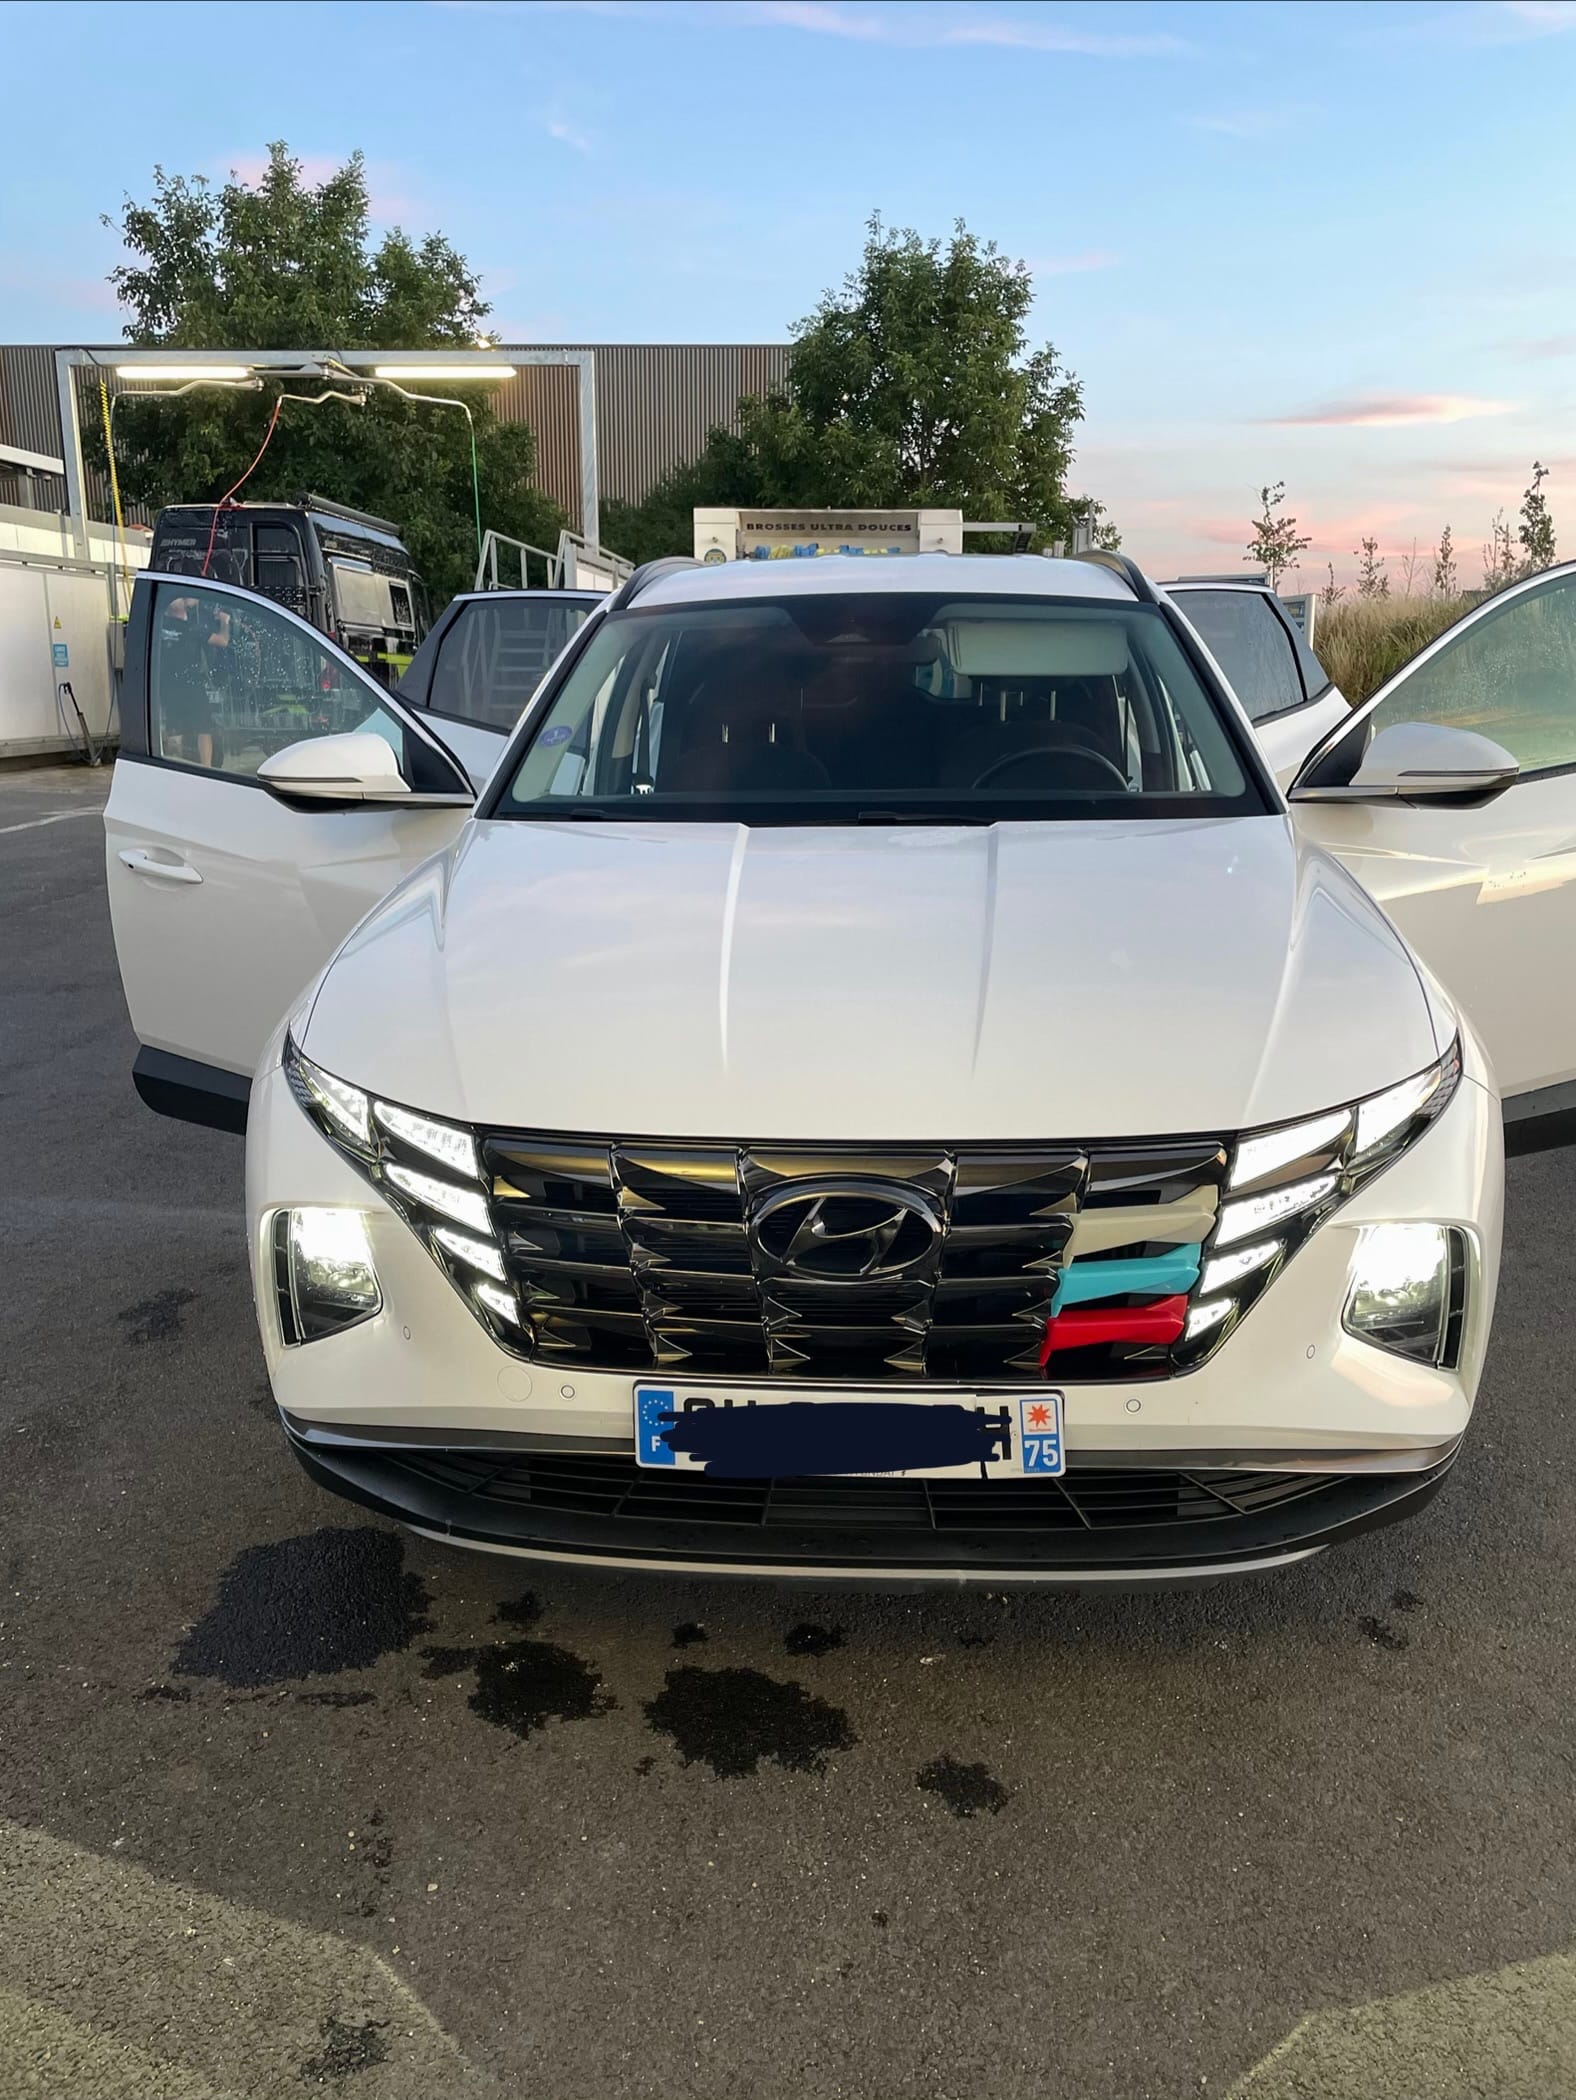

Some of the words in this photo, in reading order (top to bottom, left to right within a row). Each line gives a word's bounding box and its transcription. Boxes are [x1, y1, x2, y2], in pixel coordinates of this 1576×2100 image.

[747, 523, 805, 531] BROSSES
[810, 523, 853, 531] ULTRA
[858, 524, 912, 532] DOUCES
[651, 1435, 661, 1452] F
[1024, 1439, 1058, 1467] 75
